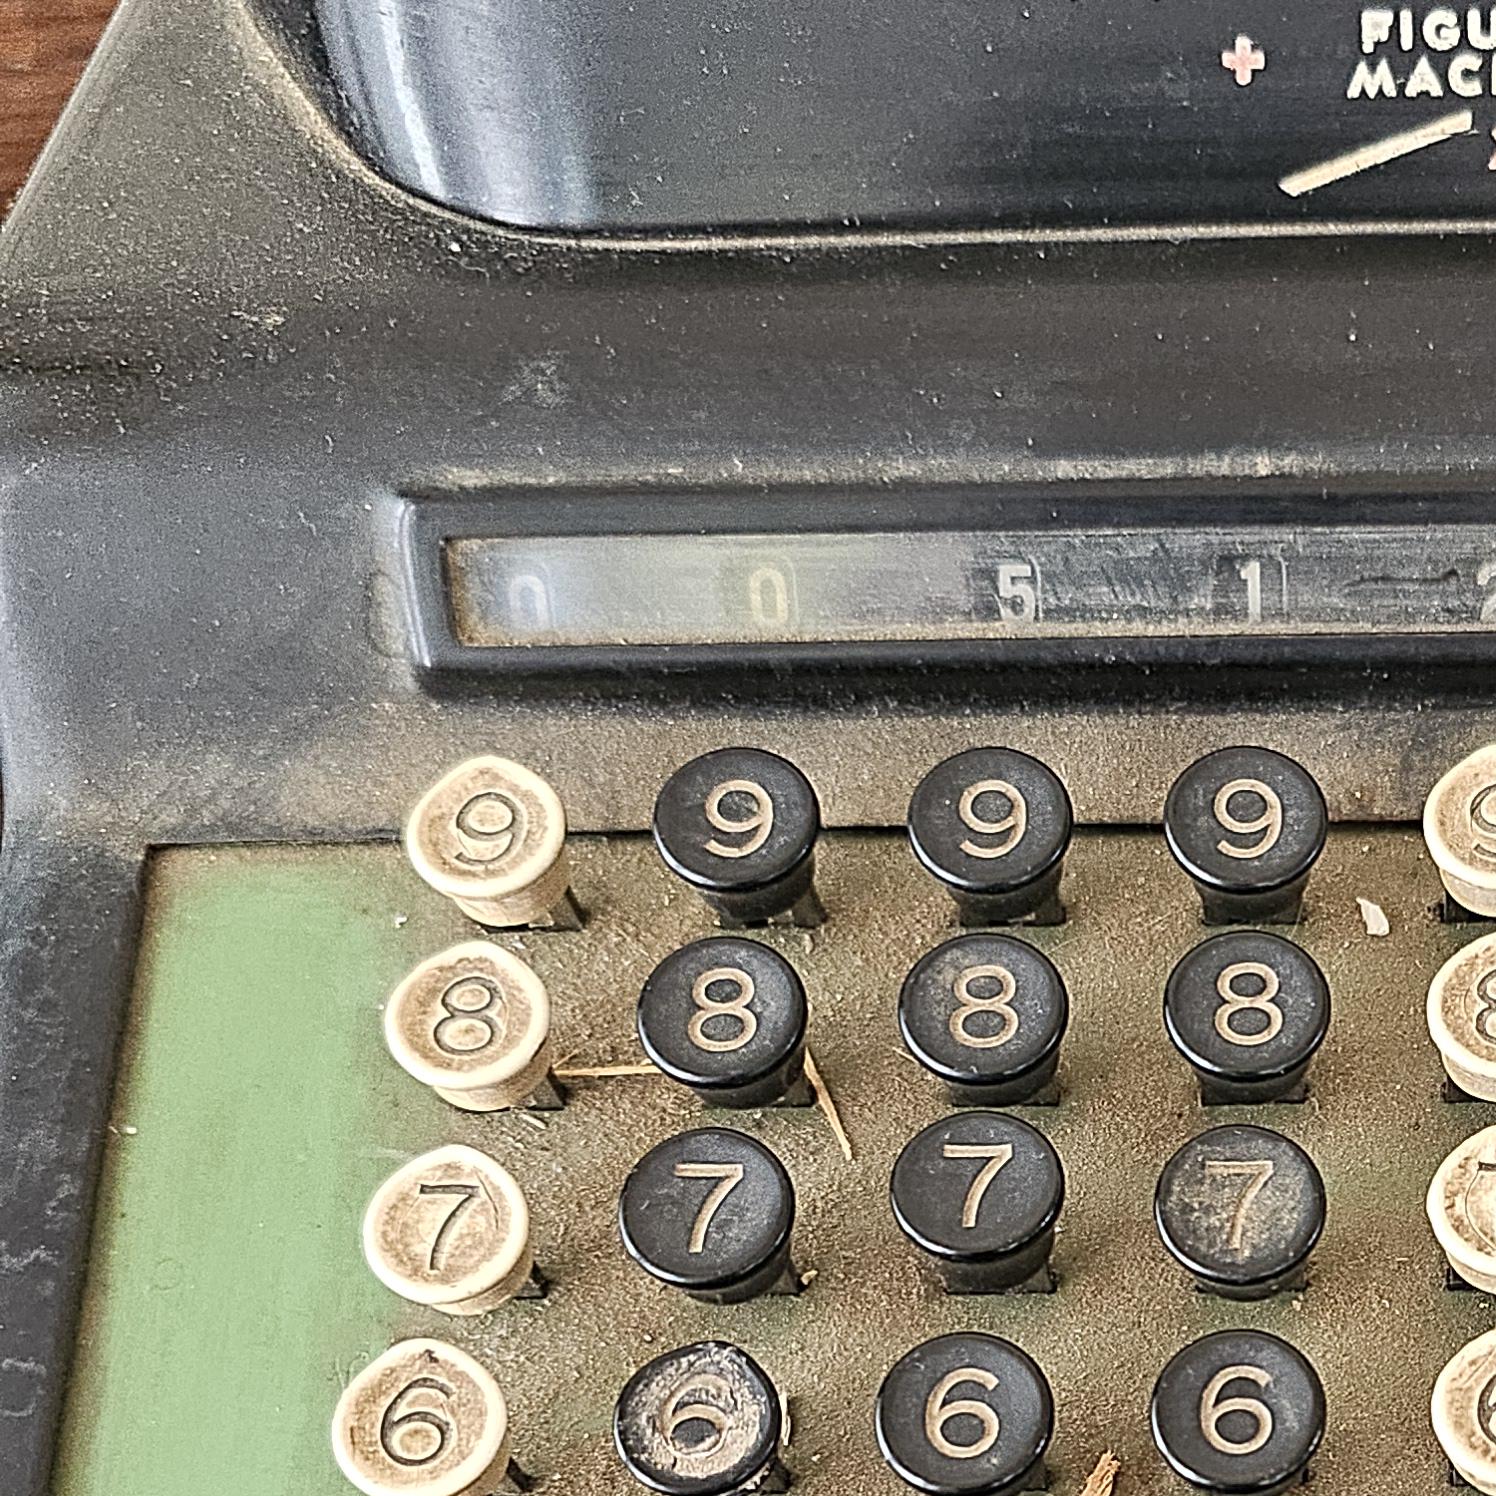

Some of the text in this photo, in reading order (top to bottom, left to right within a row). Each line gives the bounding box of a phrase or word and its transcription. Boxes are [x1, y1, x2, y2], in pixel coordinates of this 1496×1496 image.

[750, 566, 788, 624] 0
[998, 564, 1035, 622] 5
[1239, 560, 1262, 623] 1
[457, 792, 521, 863] 9
[704, 780, 774, 858] 9
[959, 780, 1027, 858] 9
[1213, 779, 1282, 859] 9
[434, 976, 502, 1052] 8
[688, 967, 758, 1052] 8
[949, 965, 1019, 1048] 8
[1215, 962, 1284, 1046] 8
[420, 1184, 480, 1270] 7
[673, 1163, 744, 1253] 7
[942, 1144, 1013, 1228] 7
[1205, 1160, 1273, 1250] 7
[380, 1377, 455, 1466] 6
[663, 1373, 729, 1455] 6
[925, 1367, 1000, 1459] 6
[1202, 1365, 1273, 1455] 6
